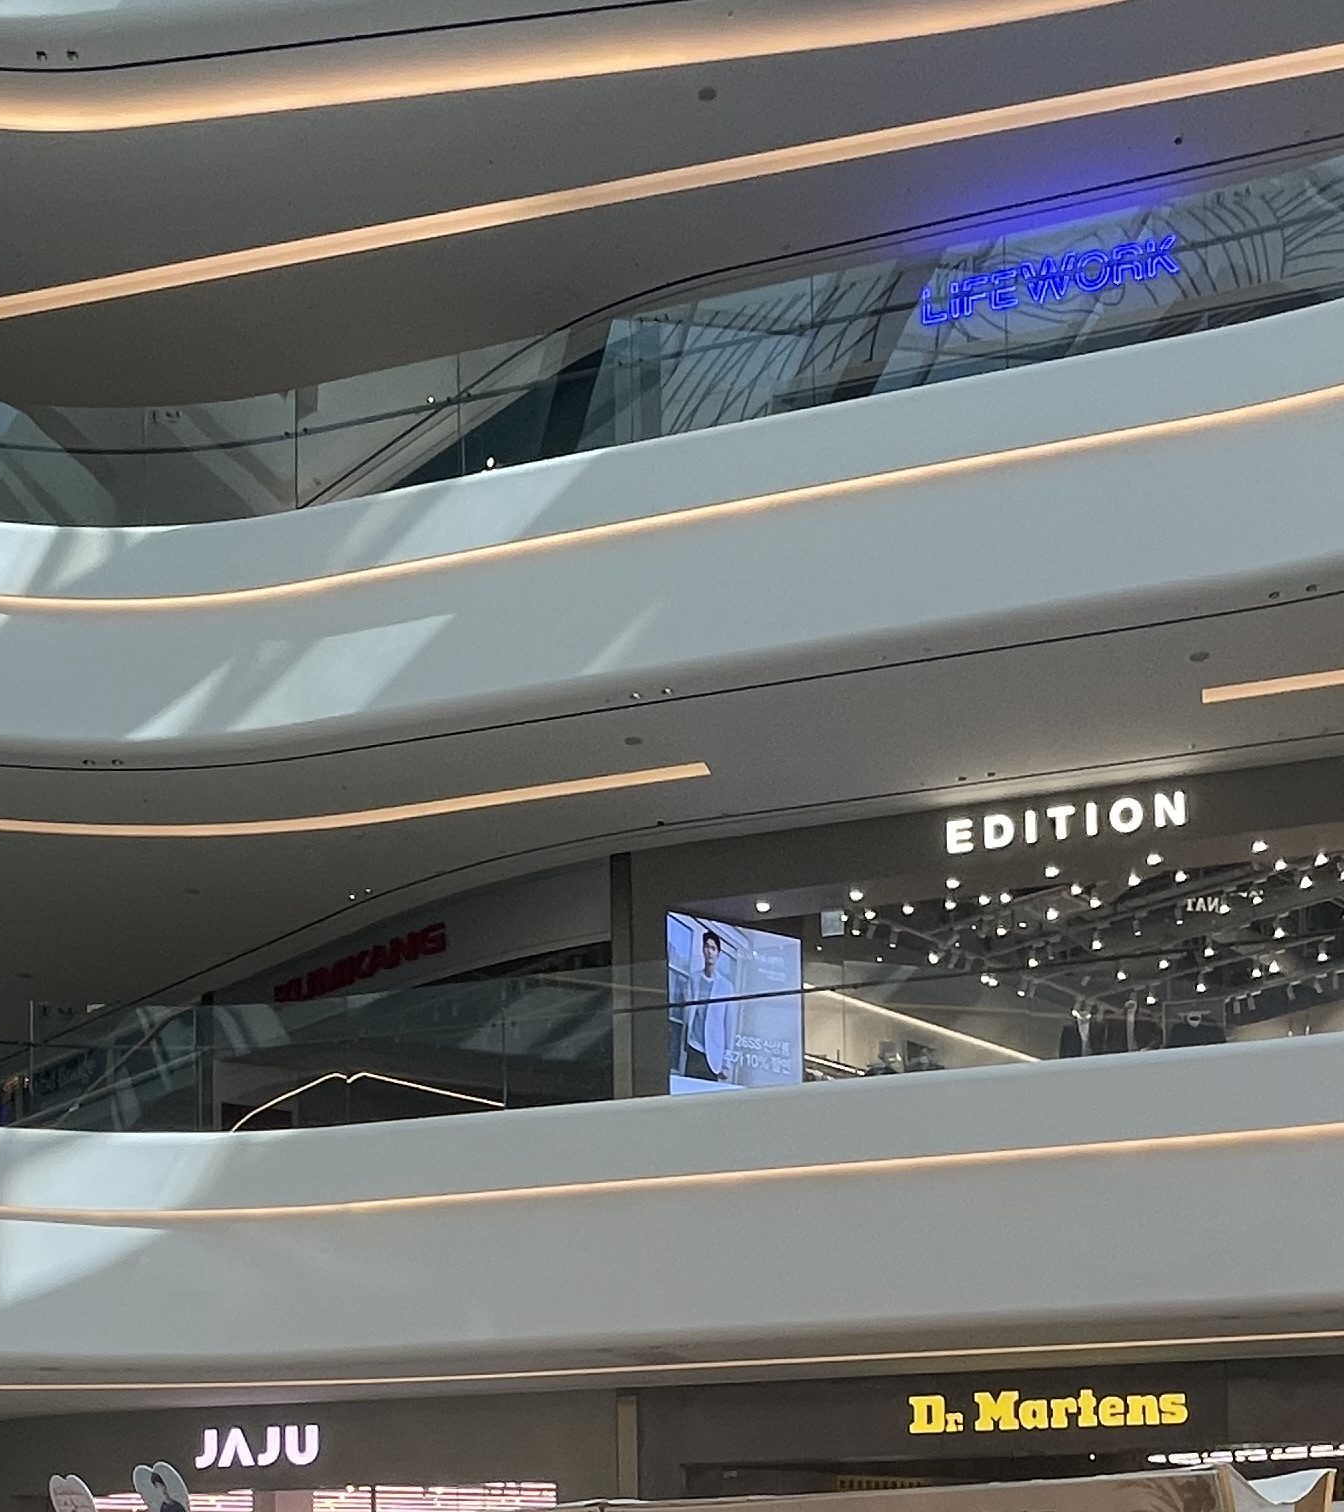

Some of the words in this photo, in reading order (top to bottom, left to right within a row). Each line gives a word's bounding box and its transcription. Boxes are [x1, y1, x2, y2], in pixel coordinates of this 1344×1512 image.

[920, 233, 1180, 326] LIFEWORK
[945, 790, 1188, 854] EDITION
[909, 1395, 963, 1434] Dr.
[974, 1388, 1188, 1430] Martens
[195, 1424, 320, 1469] JAJU
